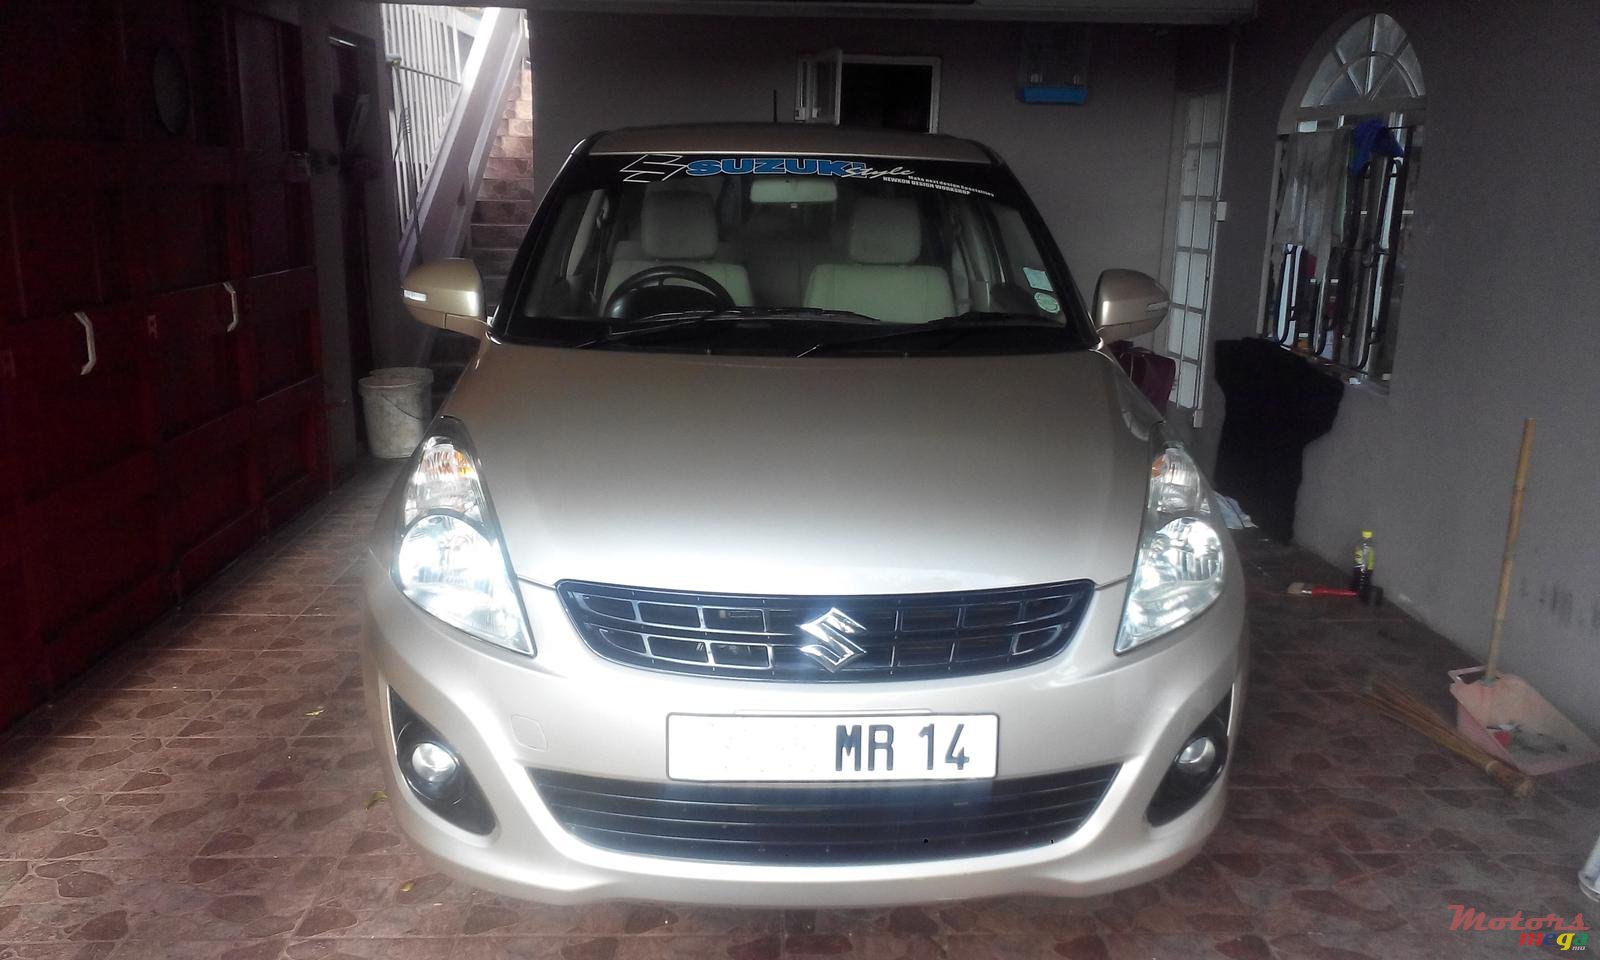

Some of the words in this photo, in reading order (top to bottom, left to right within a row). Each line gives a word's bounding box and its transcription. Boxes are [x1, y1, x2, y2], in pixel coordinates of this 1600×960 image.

[686, 158, 867, 178] SUZUKI
[841, 166, 915, 179] Style
[911, 180, 935, 189] DESIGN
[934, 184, 971, 195] WORKSHOP
[835, 724, 894, 771] MR
[918, 723, 970, 770] 14
